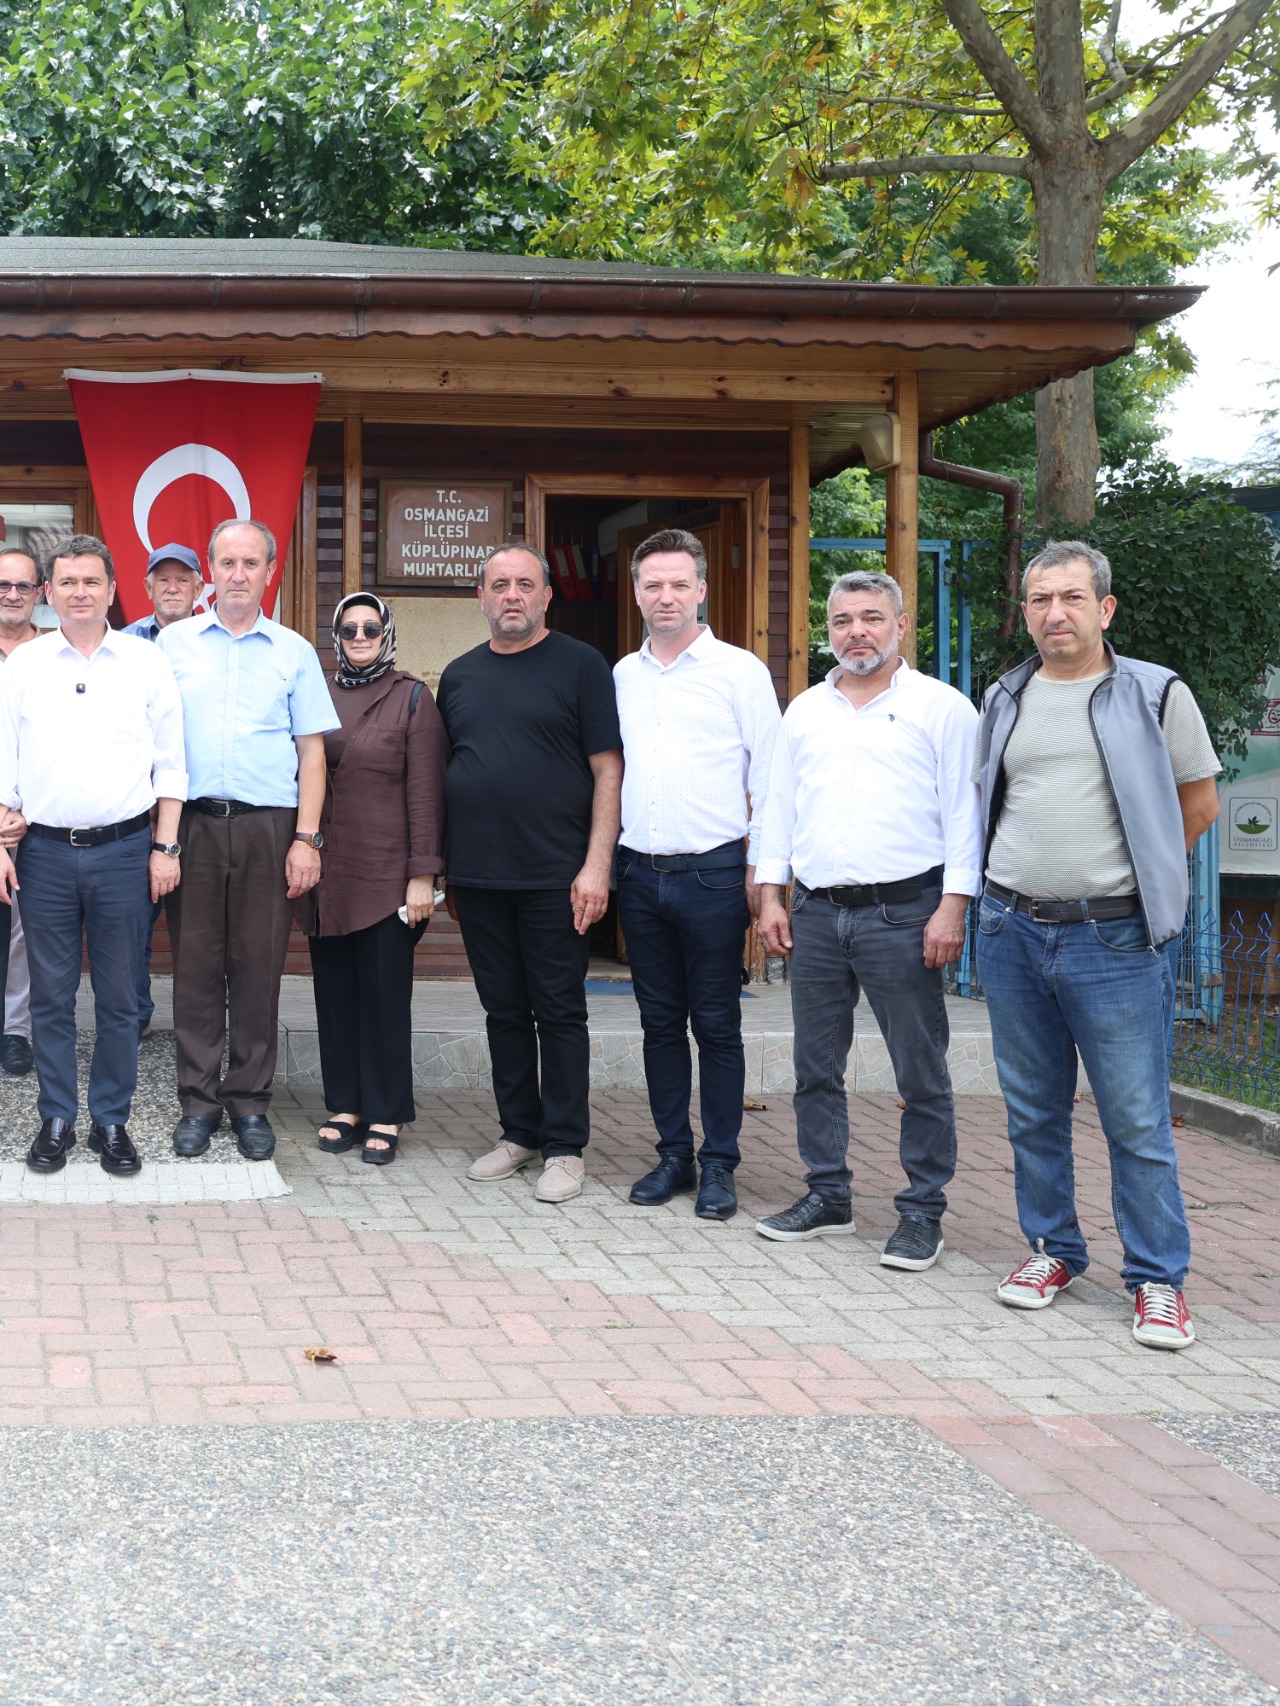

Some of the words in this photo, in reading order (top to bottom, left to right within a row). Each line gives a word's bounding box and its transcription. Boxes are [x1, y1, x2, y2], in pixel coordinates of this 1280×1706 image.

[436, 490, 462, 503] T.C.
[404, 506, 489, 522] OSMANGAZİ
[424, 521, 469, 541] İLÇESİ
[403, 560, 483, 577] MUHTARLI
